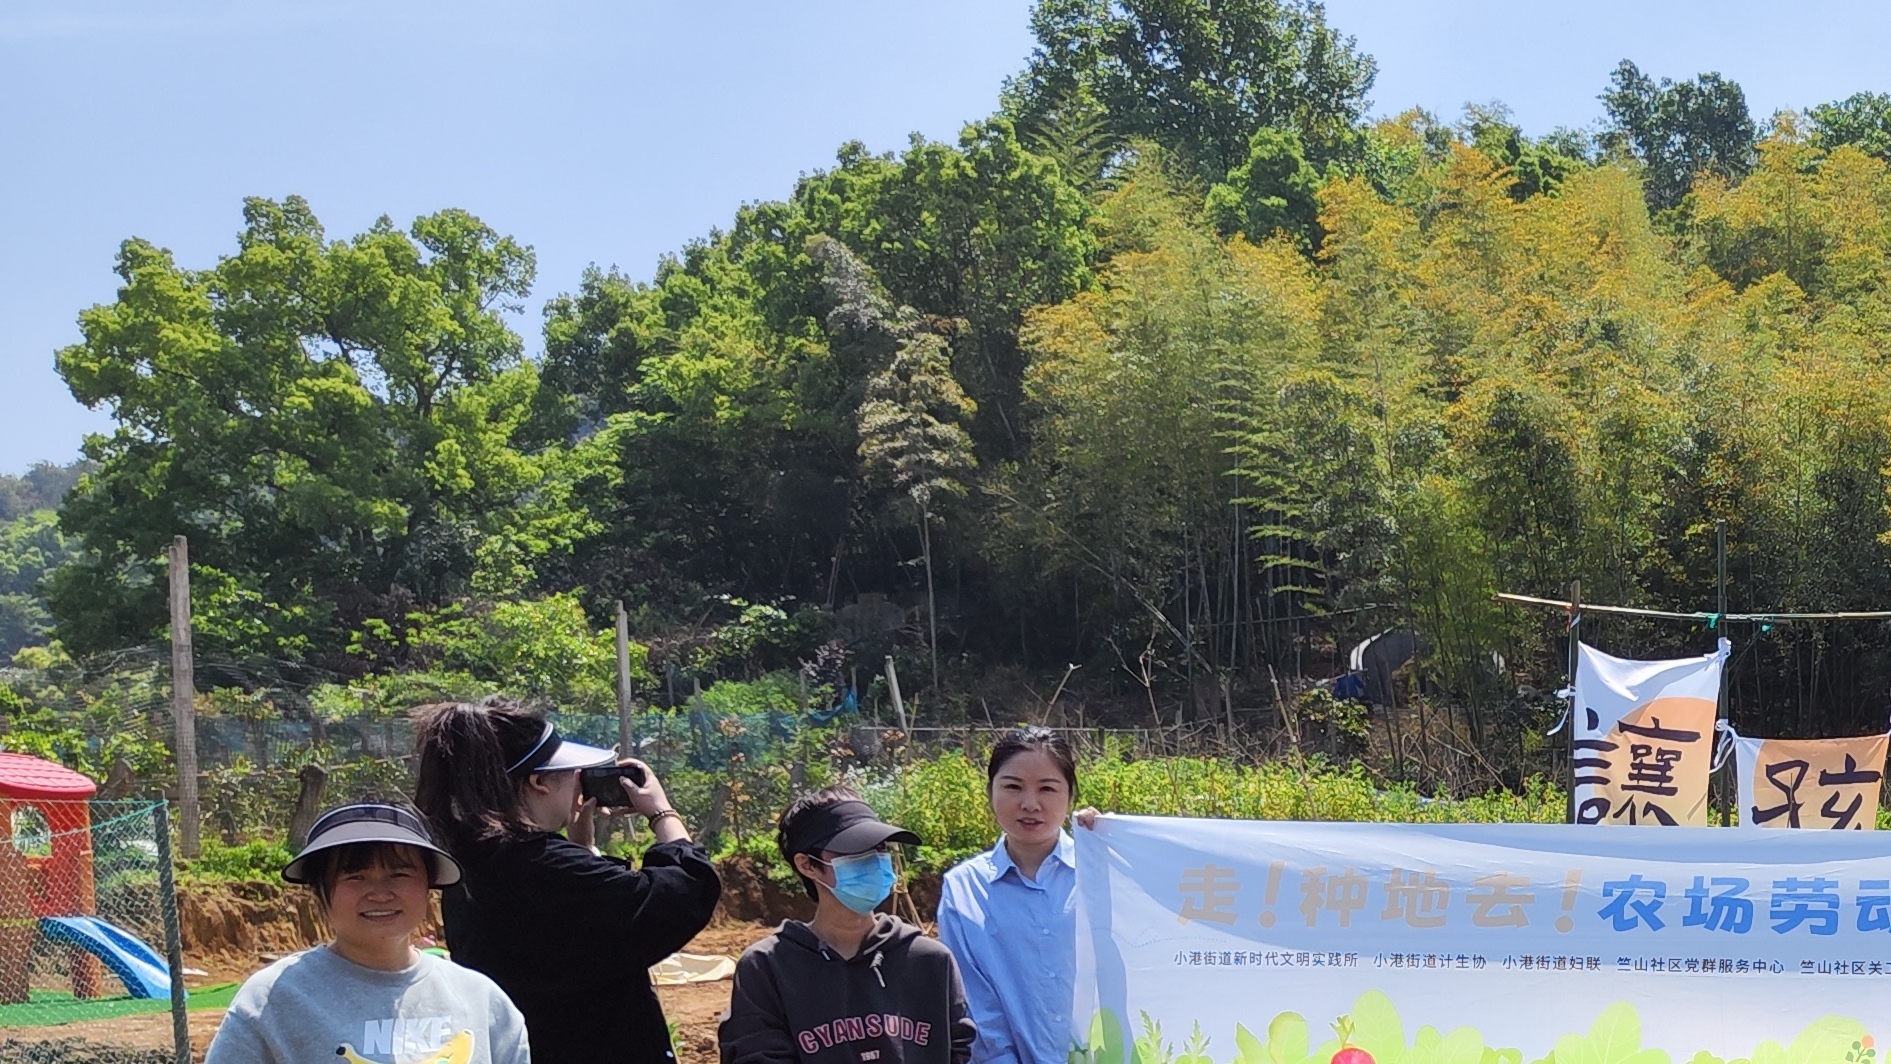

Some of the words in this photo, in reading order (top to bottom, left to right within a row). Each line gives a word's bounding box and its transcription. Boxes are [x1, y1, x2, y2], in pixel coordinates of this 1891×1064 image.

[1173, 951, 1359, 969] 小港街道新时代文明实践所
[1373, 952, 1487, 970] 小港街道计生协
[1502, 954, 1601, 972] 小港街道妇联
[1616, 956, 1784, 974] 竺山社区党群服务中心
[363, 1016, 452, 1055] NIKE
[798, 1013, 932, 1054] CYANSUDE
